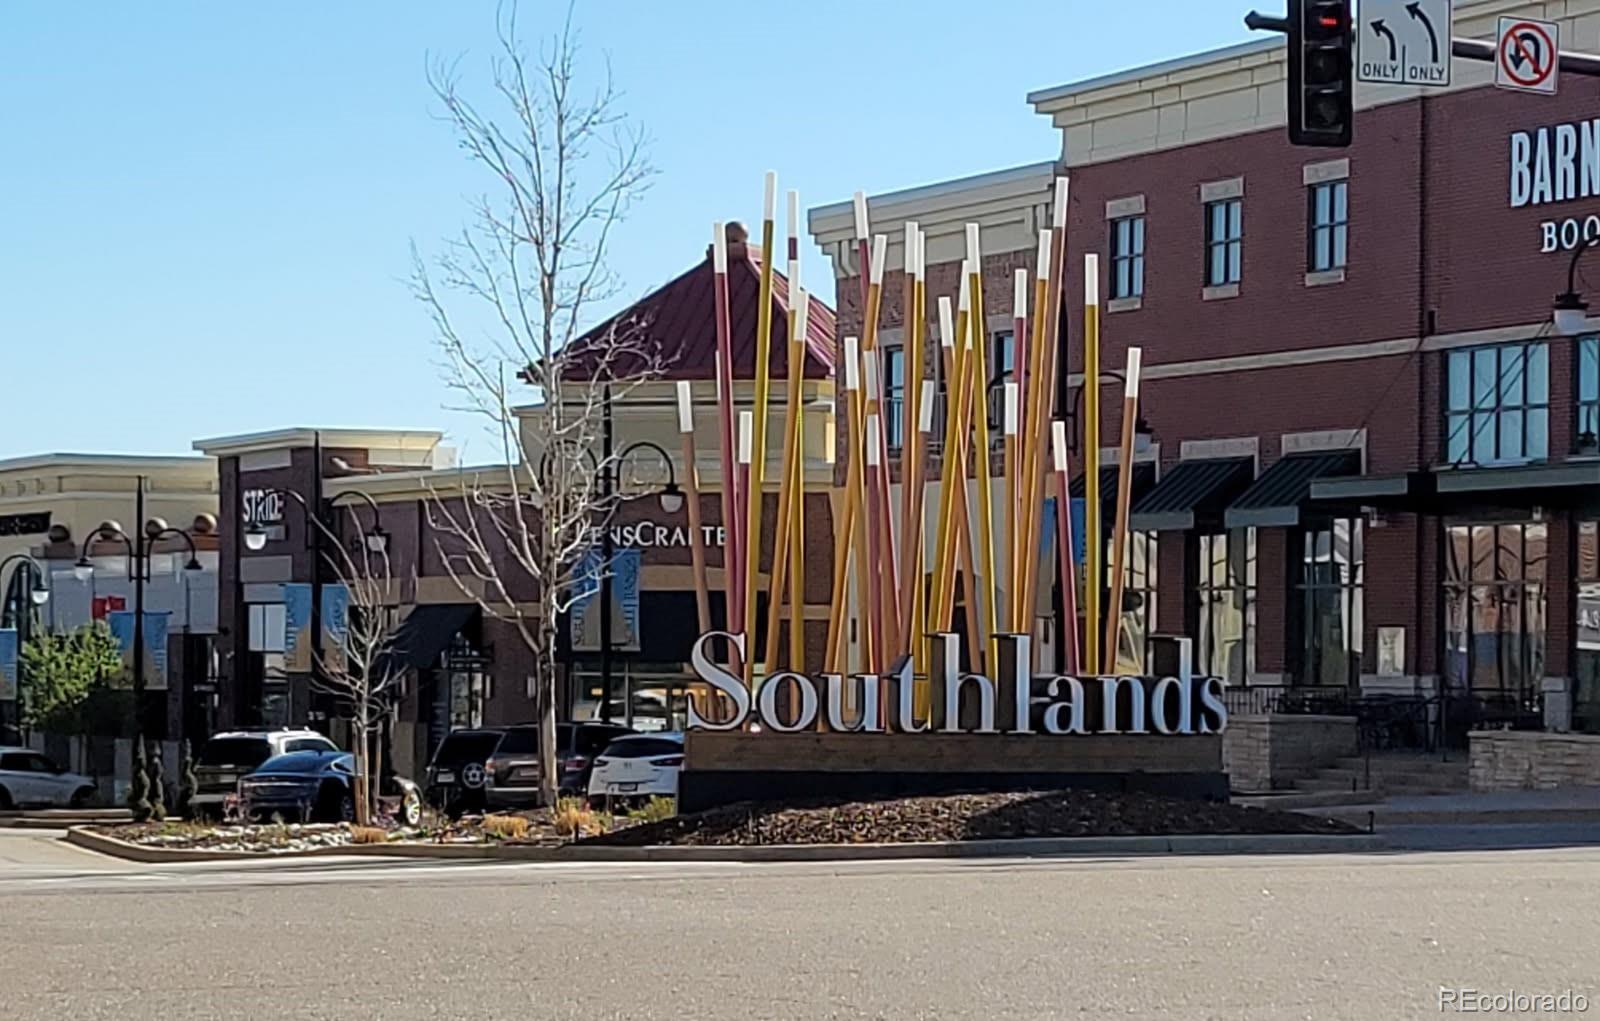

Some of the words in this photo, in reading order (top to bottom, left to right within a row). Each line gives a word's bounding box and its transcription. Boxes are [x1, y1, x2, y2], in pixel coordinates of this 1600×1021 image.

[1362, 62, 1398, 78] ONLY
[1409, 65, 1445, 80] ONLY
[1510, 118, 1600, 207] BARN
[686, 629, 1229, 735] Southlands
